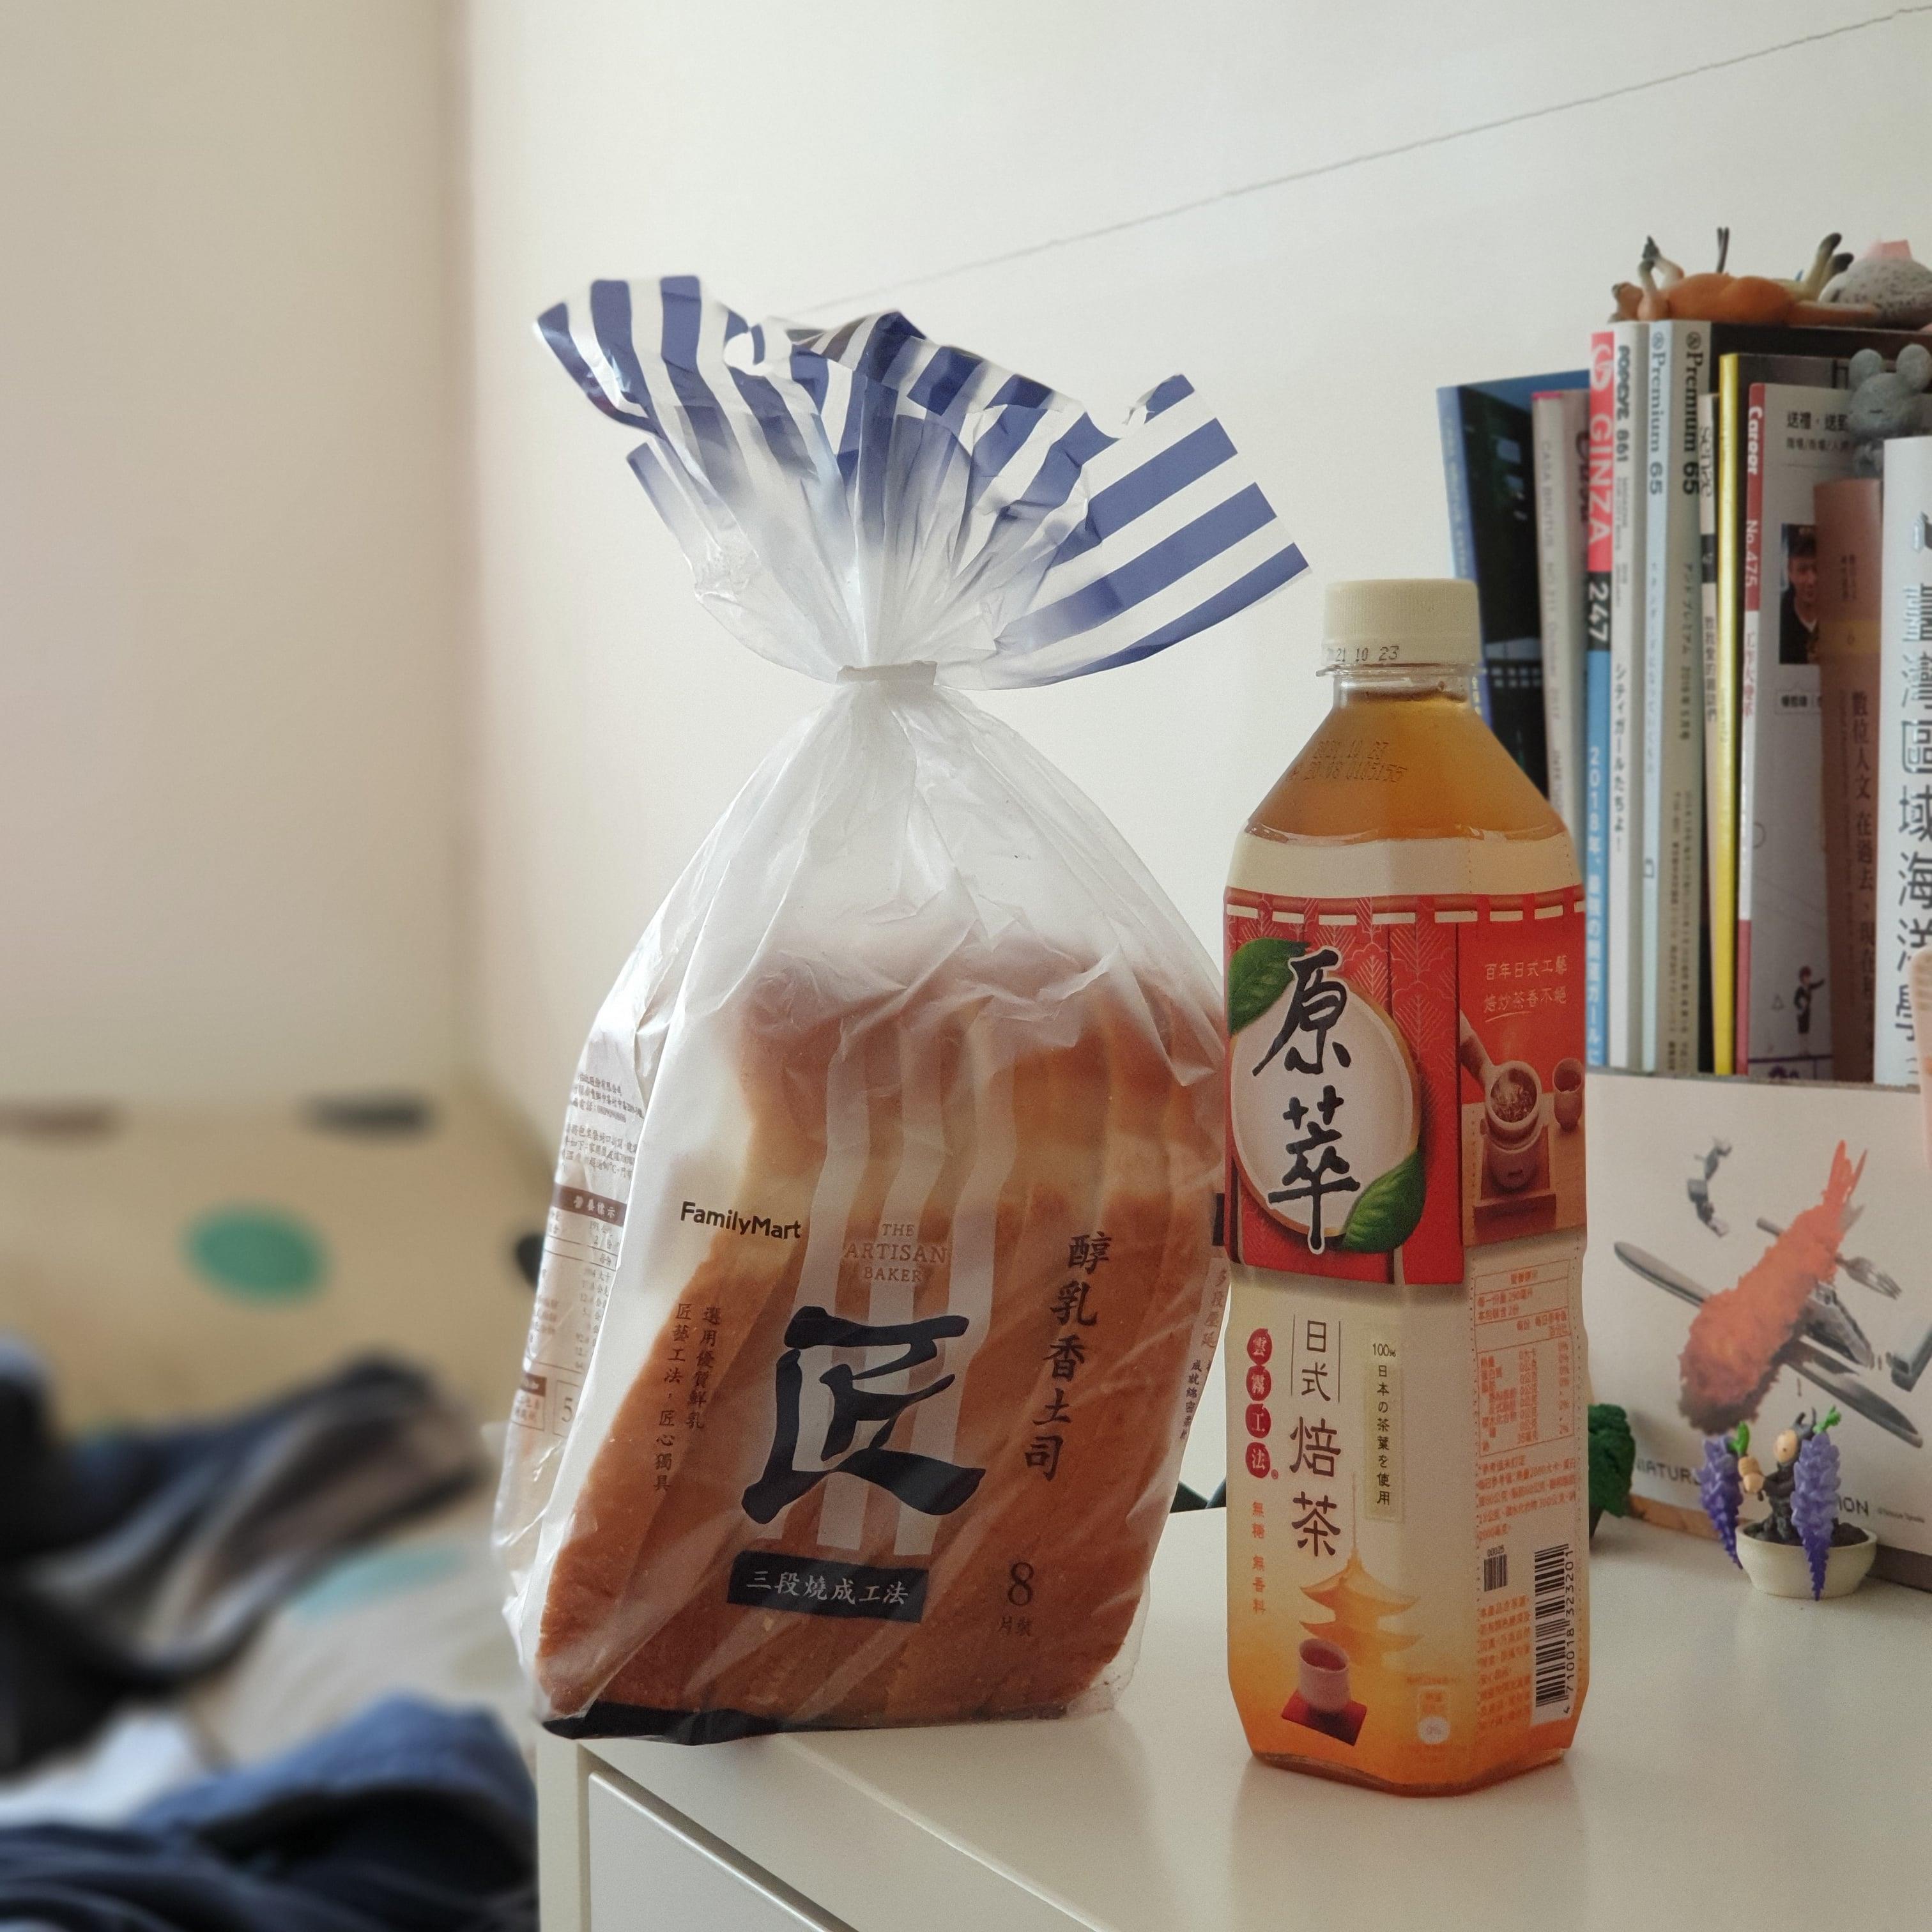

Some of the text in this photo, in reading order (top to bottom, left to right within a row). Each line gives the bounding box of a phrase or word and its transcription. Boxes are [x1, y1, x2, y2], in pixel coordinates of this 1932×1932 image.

[1617, 345, 1630, 420] POPEYE
[1747, 405, 1763, 475] Career
[1589, 413, 1613, 546] GINZA
[1650, 461, 1662, 496] 65
[1683, 461, 1698, 496] 65
[1588, 581, 1608, 643] 247
[1379, 646, 1399, 661] 23
[1252, 948, 1361, 1251] 原萃
[680, 1200, 801, 1241] FamilyMart
[843, 1242, 948, 1263] ARTISAN
[882, 1223, 915, 1236] THE
[1025, 1230, 1112, 1482] 醇乳香土司
[741, 1305, 986, 1524] 匠
[1289, 1319, 1342, 1557] 日式焙茶
[1372, 1343, 1397, 1506] 100% 日本の茶葉を使用
[1636, 1458, 1702, 1486] NATUR
[746, 1570, 908, 1605] 三段燒成工法
[1008, 1561, 1034, 1606] 8
[1565, 1549, 1575, 1619] 323201
[1566, 1627, 1575, 1694] 710018
